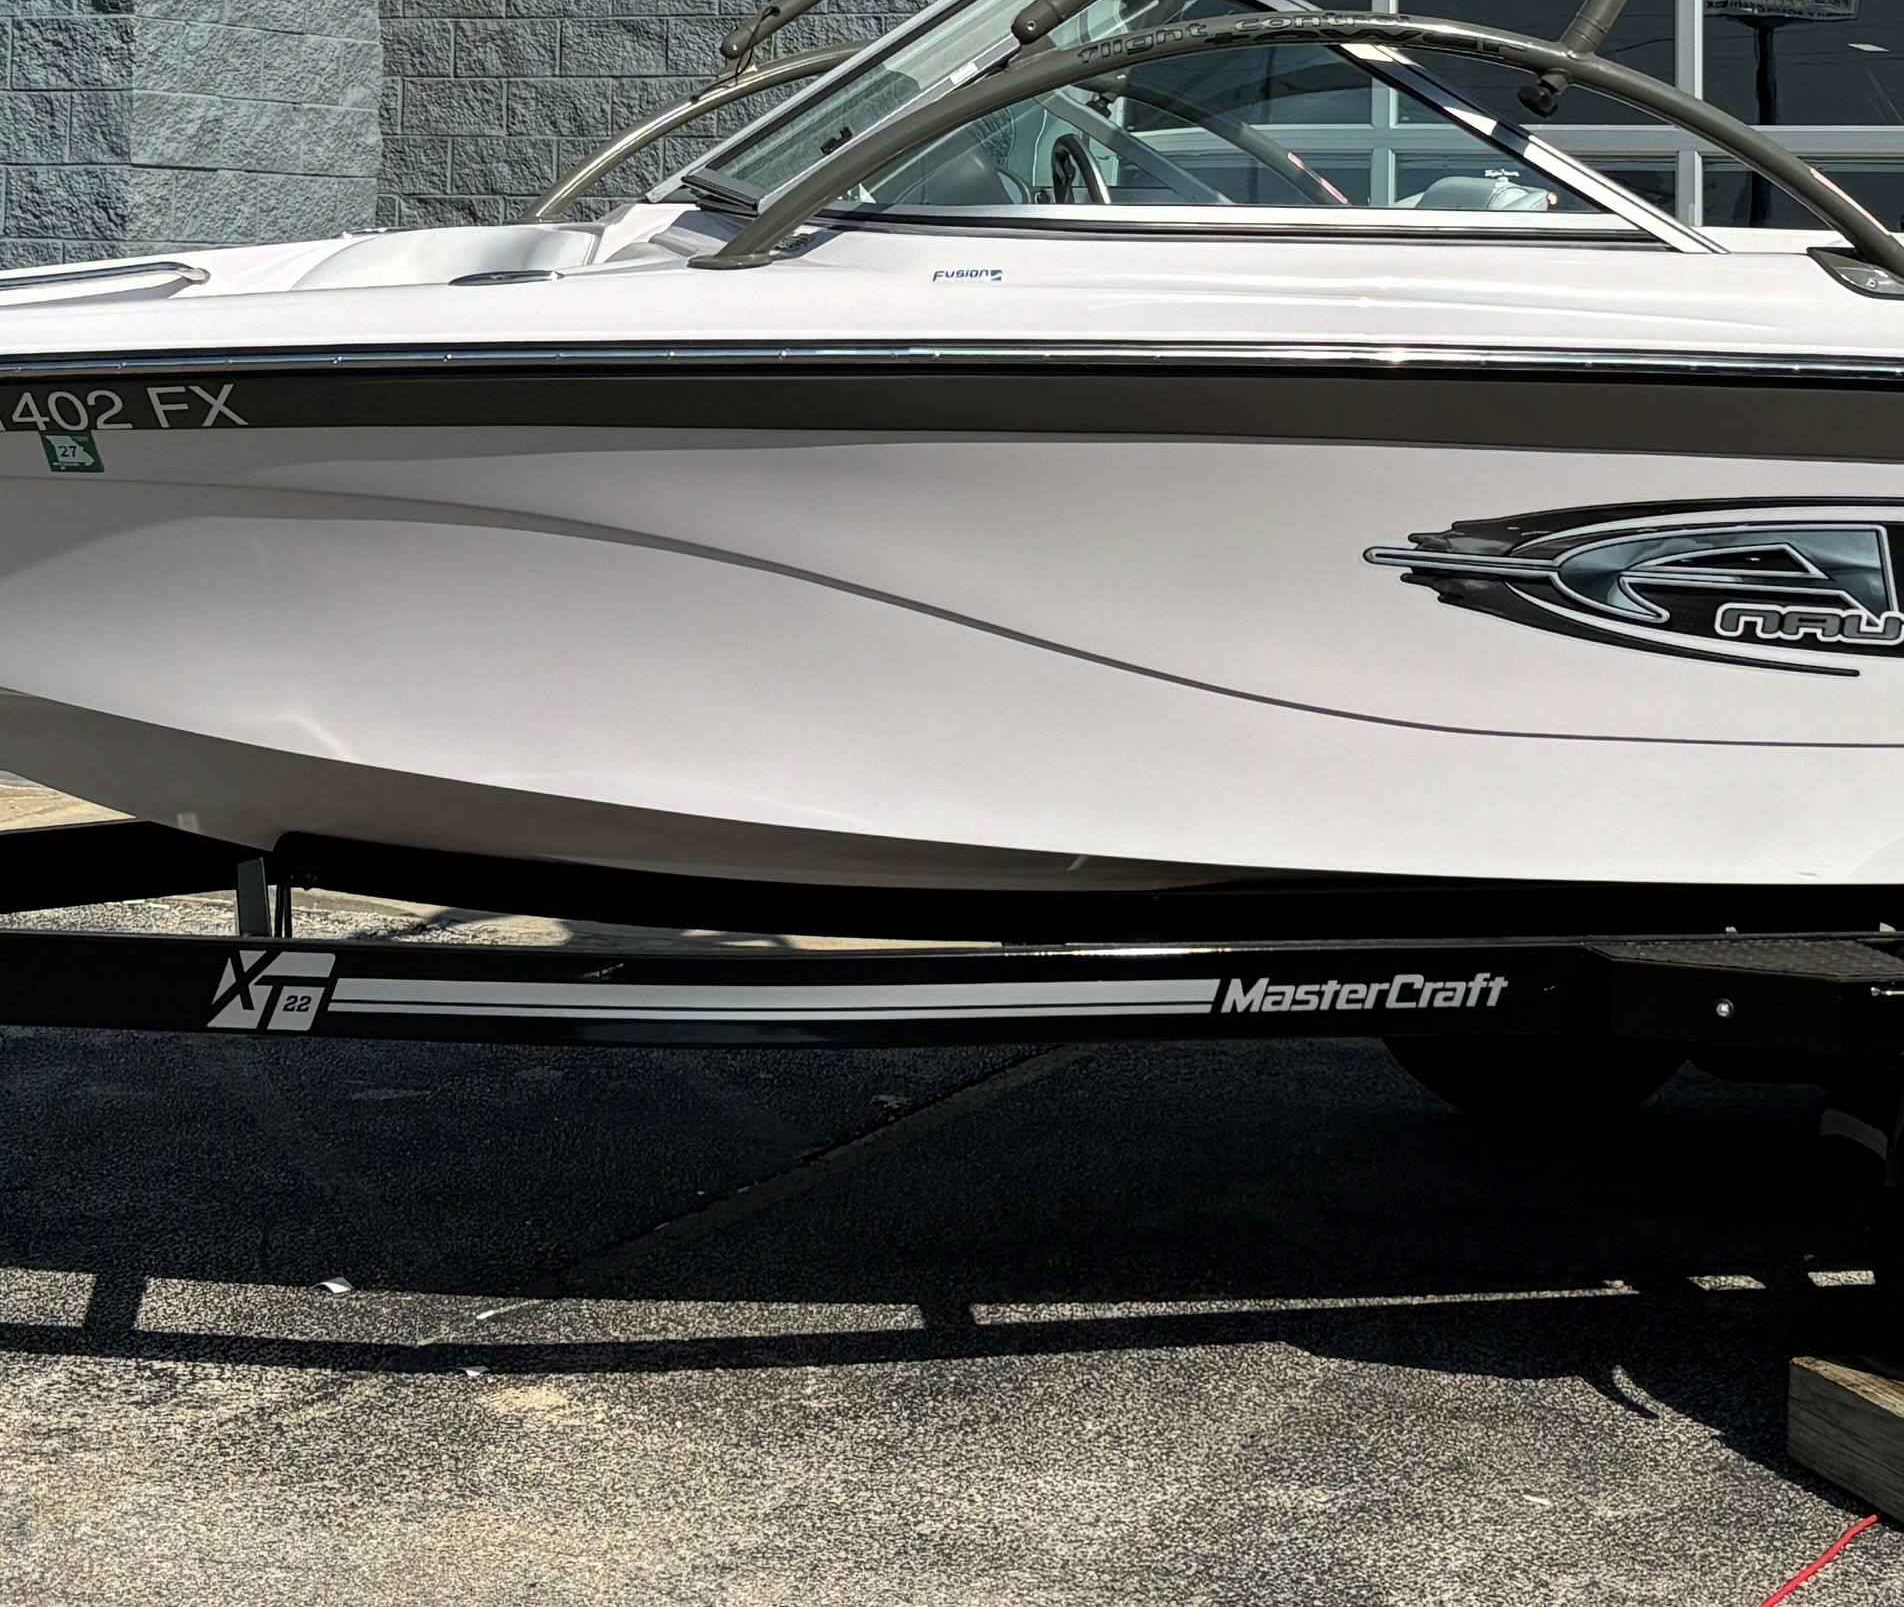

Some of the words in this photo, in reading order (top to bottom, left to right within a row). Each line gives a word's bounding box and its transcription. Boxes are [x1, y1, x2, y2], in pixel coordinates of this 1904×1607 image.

[146, 383, 249, 429] FX
[58, 444, 77, 459] 27
[203, 949, 332, 1031] XT
[282, 994, 313, 1013] 22
[1219, 972, 1509, 1015] MasterCraft
